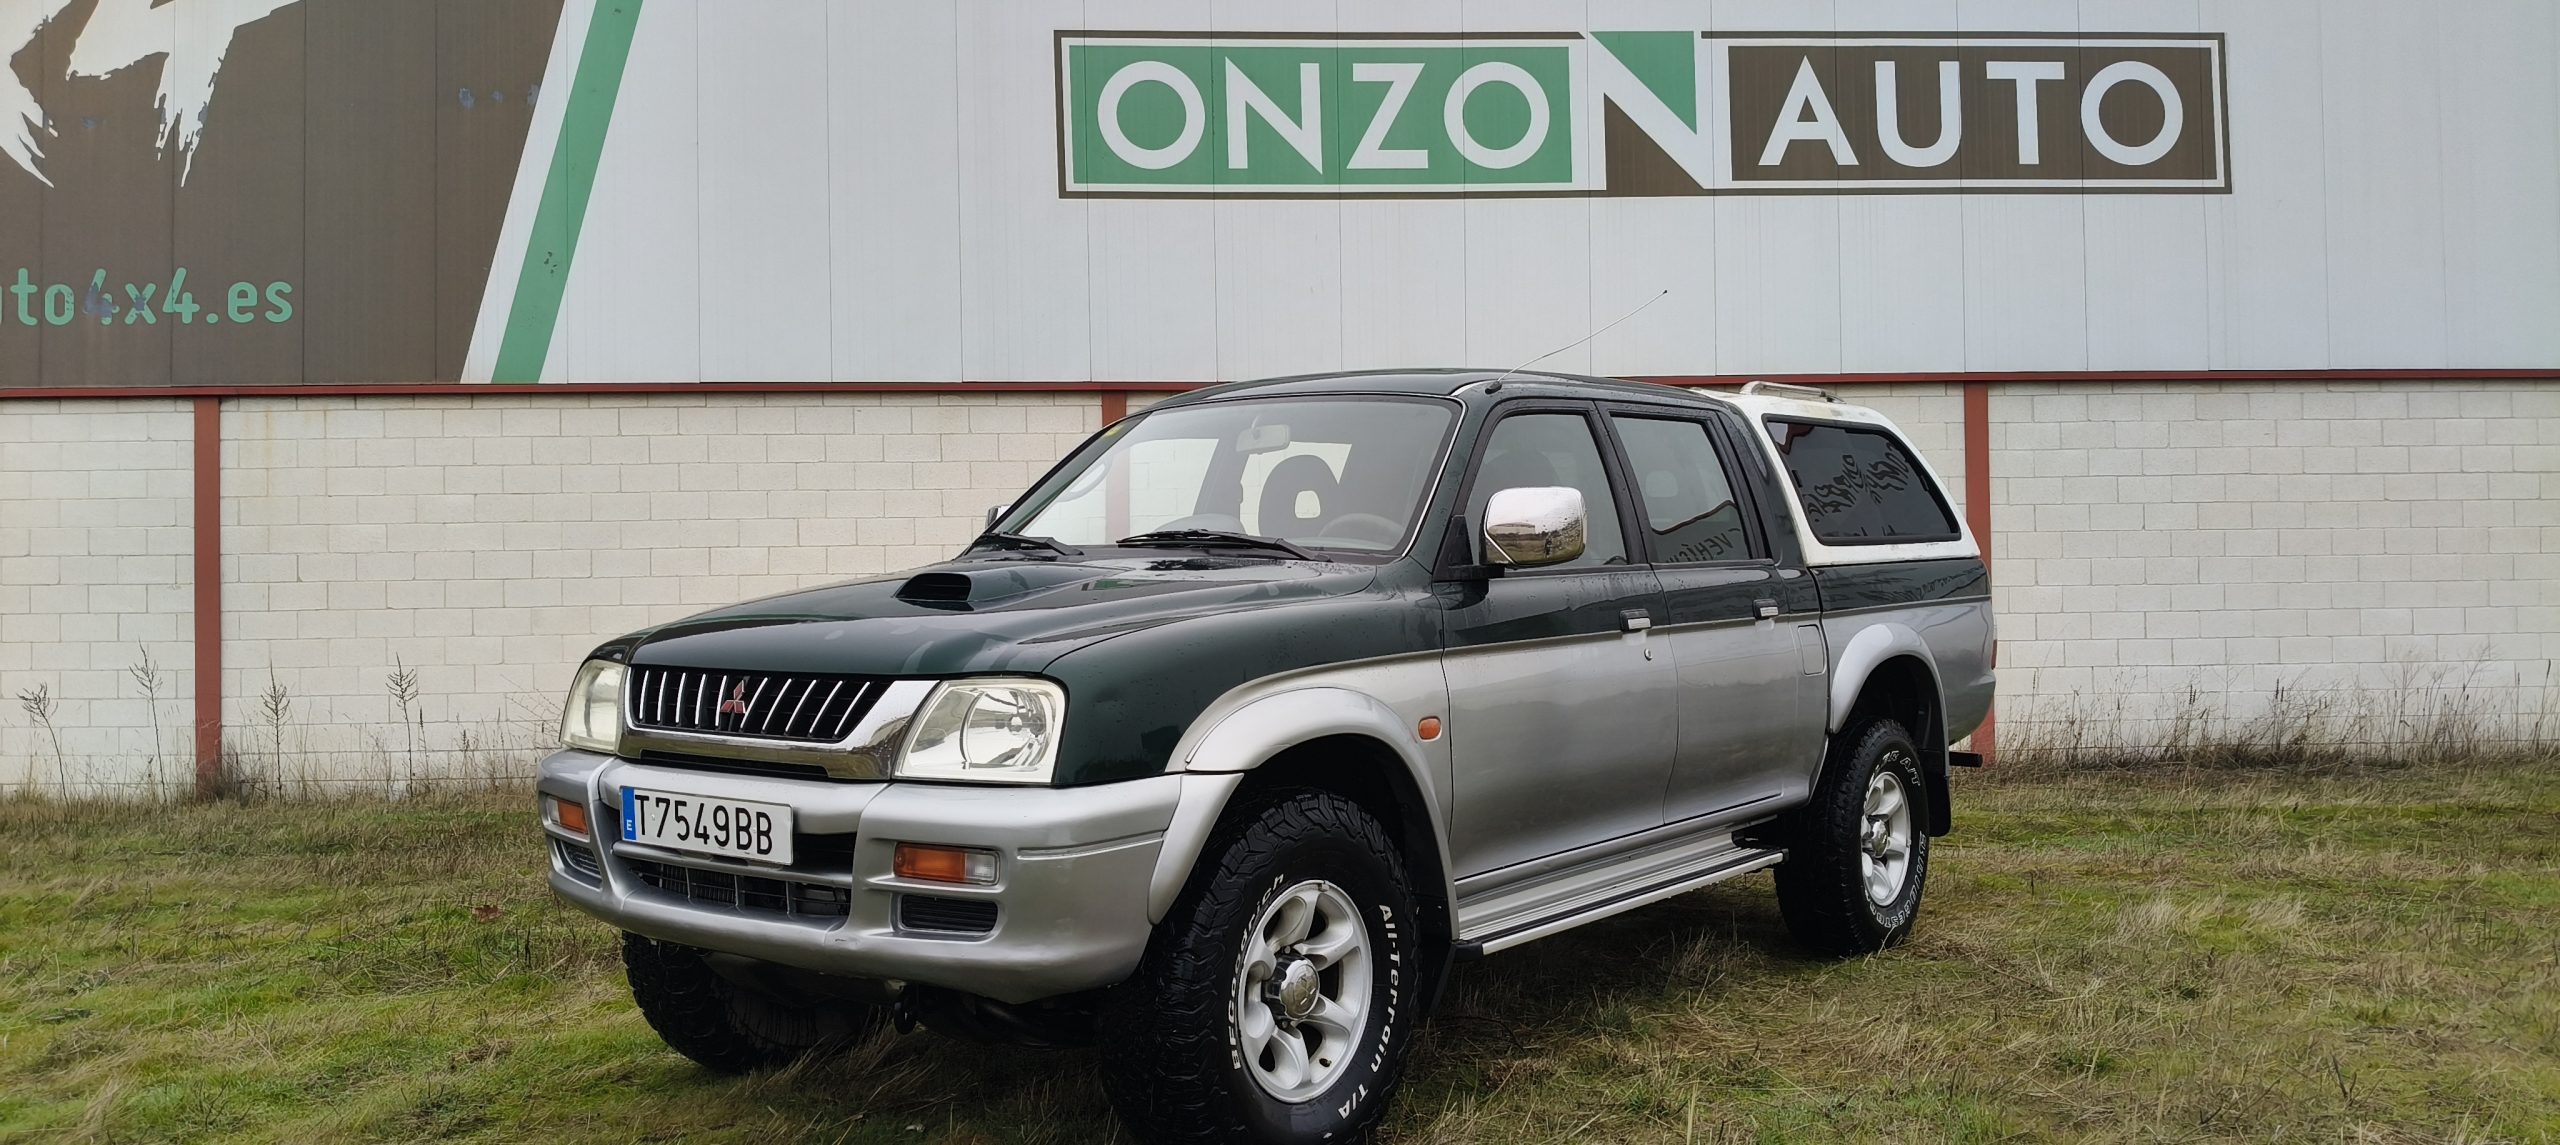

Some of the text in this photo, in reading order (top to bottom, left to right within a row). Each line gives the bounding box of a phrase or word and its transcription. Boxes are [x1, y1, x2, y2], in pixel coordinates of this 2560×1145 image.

[1758, 55, 2183, 167] AUTO
[0, 267, 293, 326] to4x4.es
[626, 819, 633, 831] E
[634, 794, 773, 855] T7549BB
[1337, 904, 1400, 1119] All-Terrain T/A
